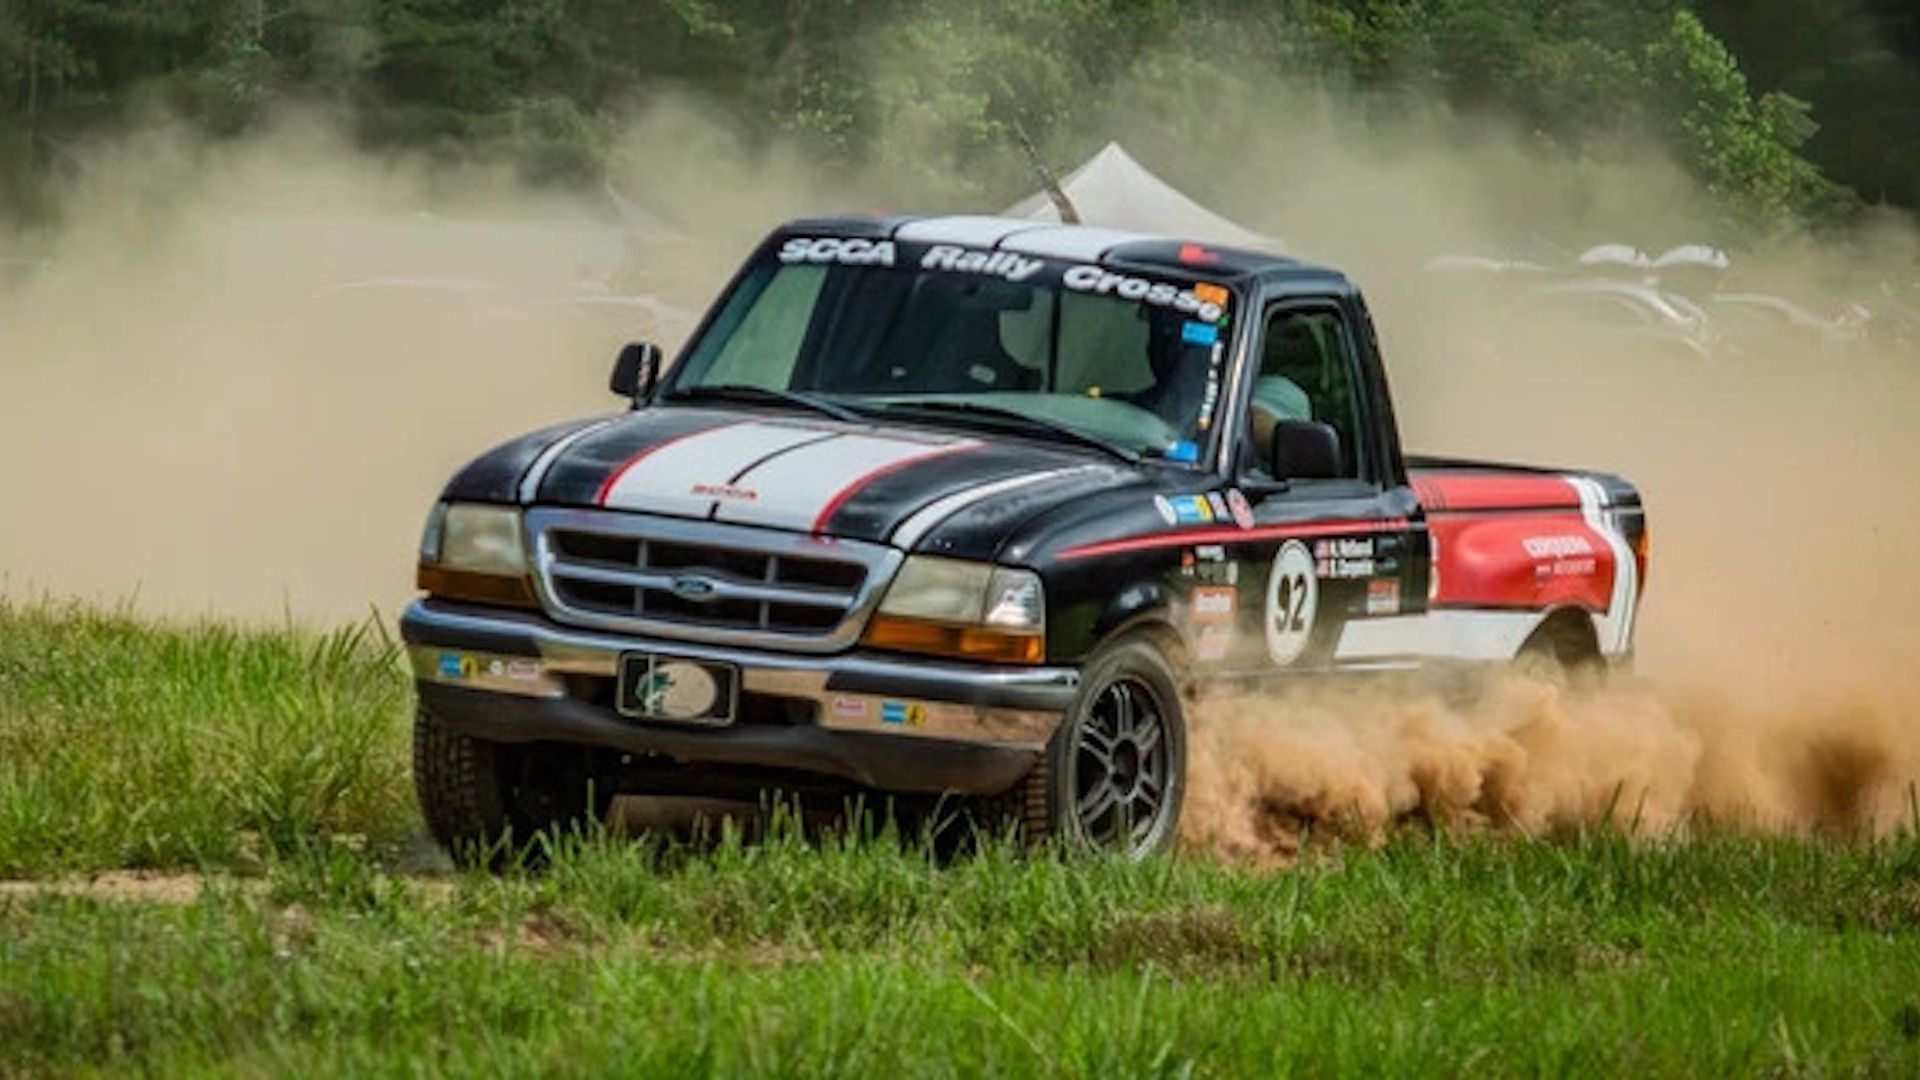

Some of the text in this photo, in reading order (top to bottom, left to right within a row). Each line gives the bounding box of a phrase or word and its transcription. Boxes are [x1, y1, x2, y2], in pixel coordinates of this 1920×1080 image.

[778, 237, 896, 266] SCCA
[920, 244, 1044, 281] Rally
[1274, 573, 1308, 633] 92
